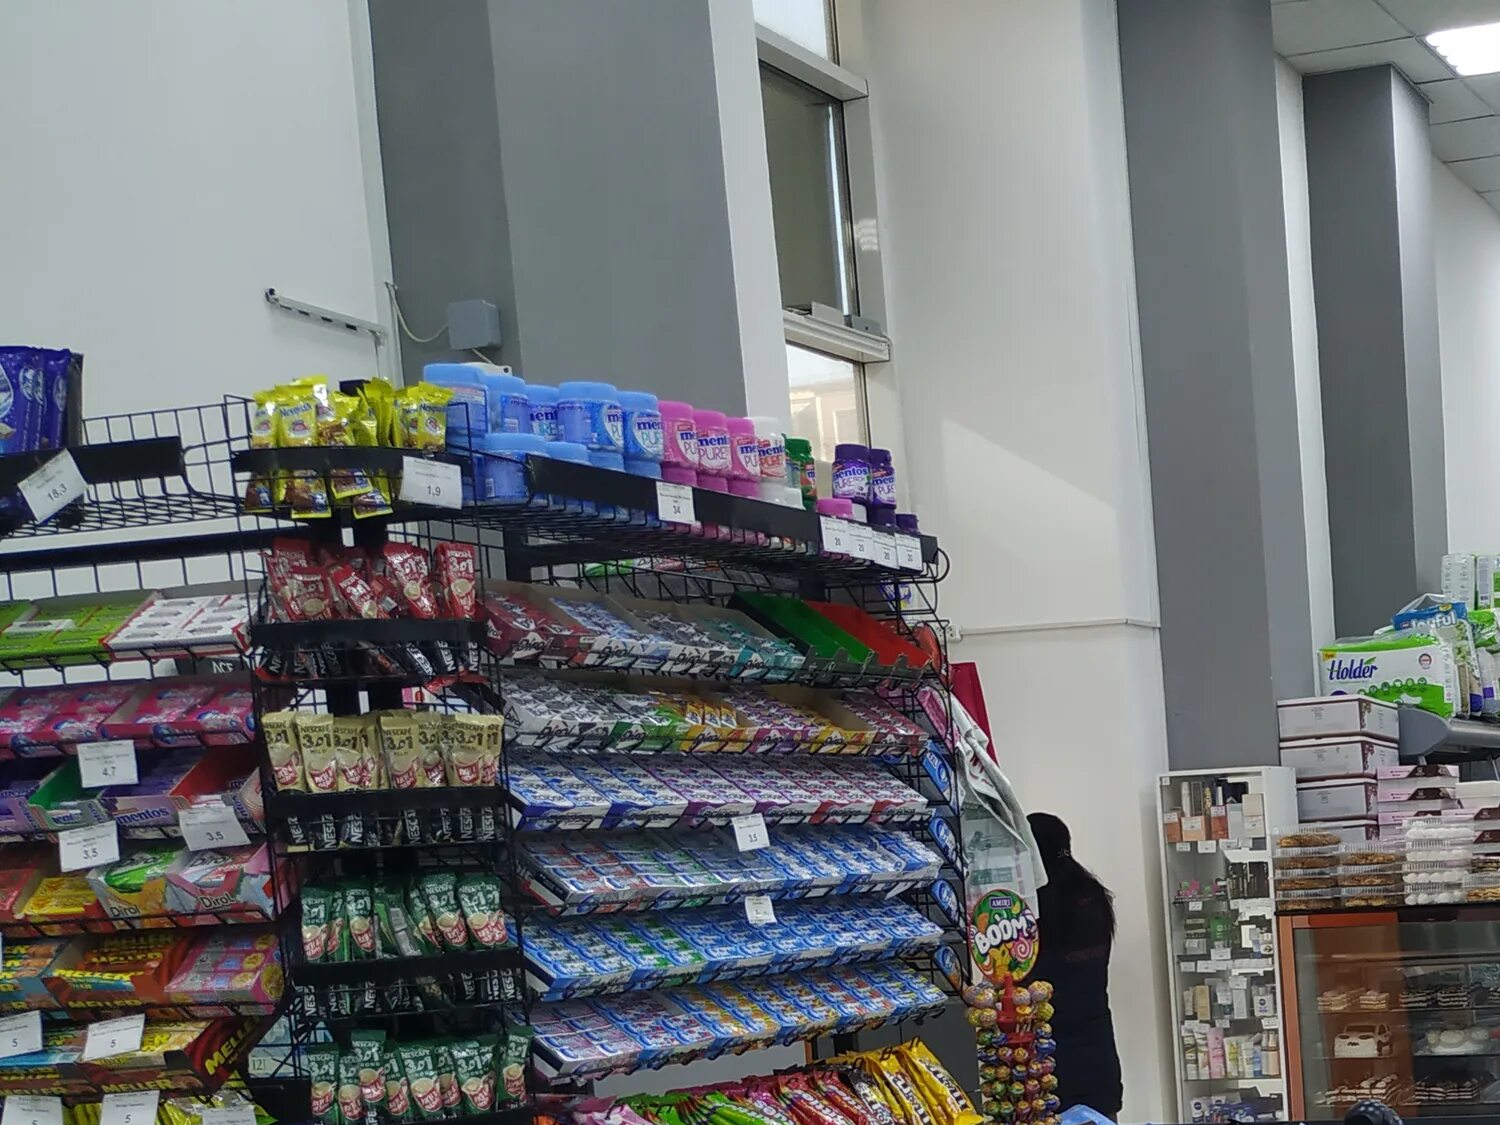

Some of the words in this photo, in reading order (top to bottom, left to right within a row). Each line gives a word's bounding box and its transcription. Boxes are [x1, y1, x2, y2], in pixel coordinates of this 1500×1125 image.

[832, 467, 870, 481] mentos
[48, 483, 68, 502] 18,3
[426, 485, 441, 497] 1,9
[1327, 657, 1377, 681] Holder
[117, 807, 169, 825] mentos
[207, 831, 224, 841] 3,5
[83, 848, 98, 861] 3,5
[201, 893, 235, 909] Dirol
[110, 905, 141, 917] Dirol
[974, 917, 1029, 954] BOOM
[12, 1038, 18, 1048] 5
[110, 1039, 116, 1048] 5
[125, 1114, 131, 1123] 5
